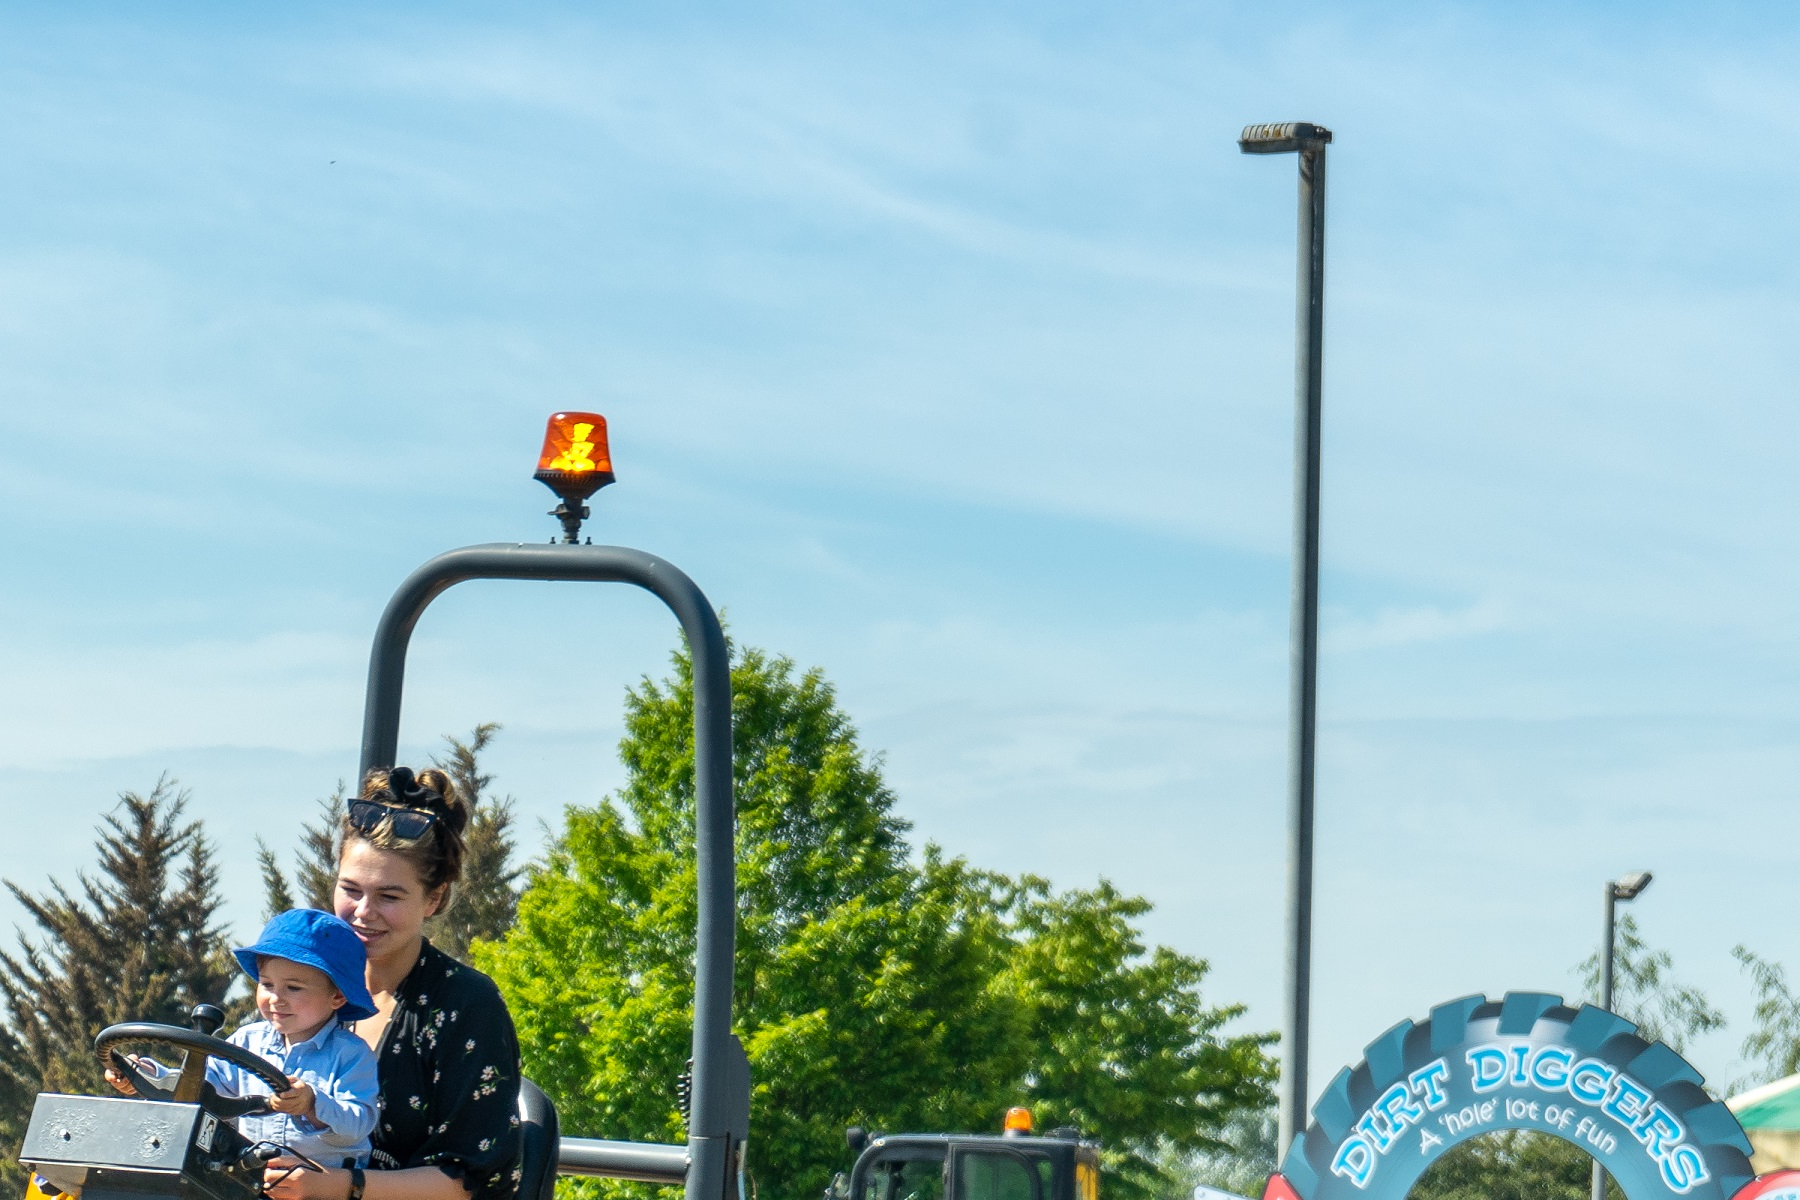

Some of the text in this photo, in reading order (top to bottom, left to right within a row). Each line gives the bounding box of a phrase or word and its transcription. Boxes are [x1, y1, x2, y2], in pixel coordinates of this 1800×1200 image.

[1330, 1044, 1712, 1195] DIRT DIGGERS
[1418, 1128, 1443, 1156] A
[1505, 1097, 1539, 1121] lot
[1544, 1103, 1576, 1131] of
[1574, 1115, 1618, 1156] fun
